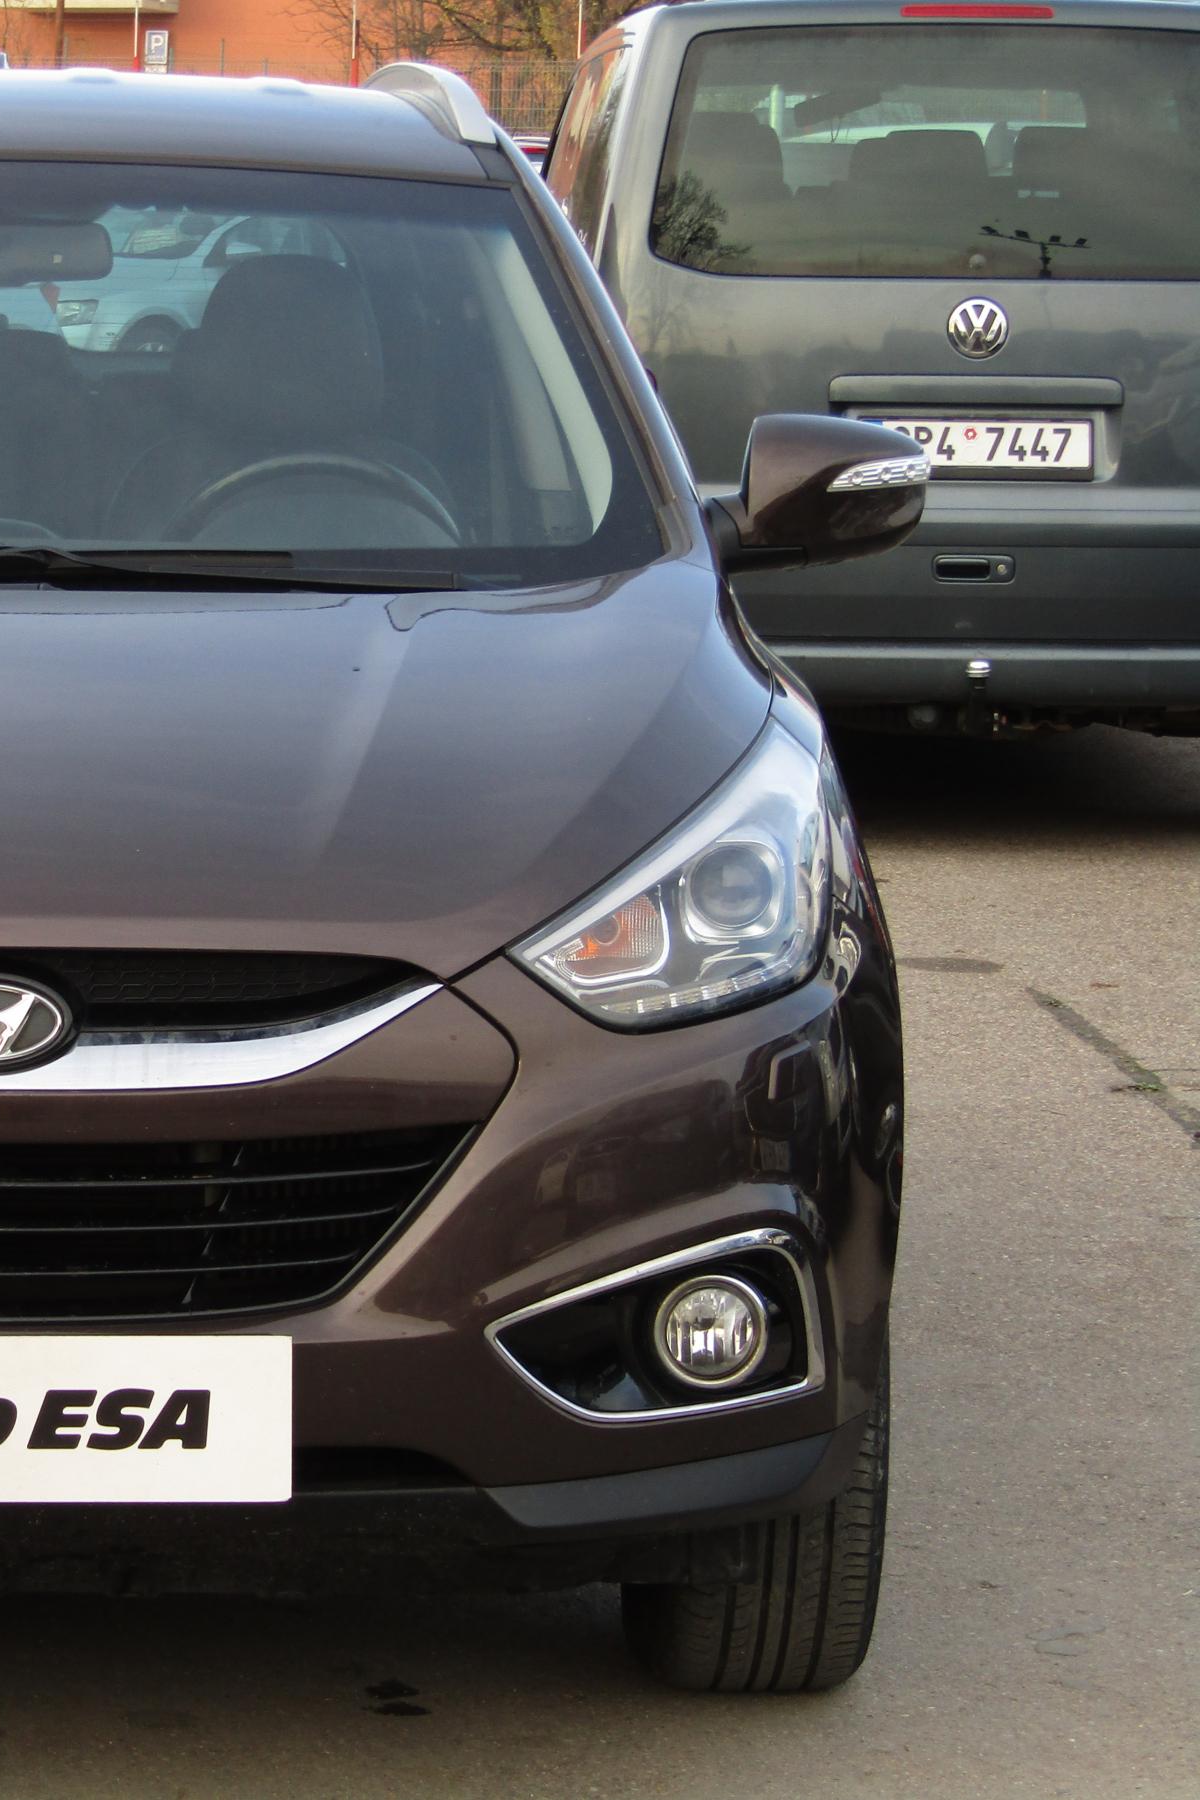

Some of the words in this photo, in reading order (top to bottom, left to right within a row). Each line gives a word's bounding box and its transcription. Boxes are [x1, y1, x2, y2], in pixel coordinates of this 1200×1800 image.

[948, 298, 1008, 358] VW
[986, 427, 1072, 462] 7447
[27, 1388, 211, 1450] ESA
